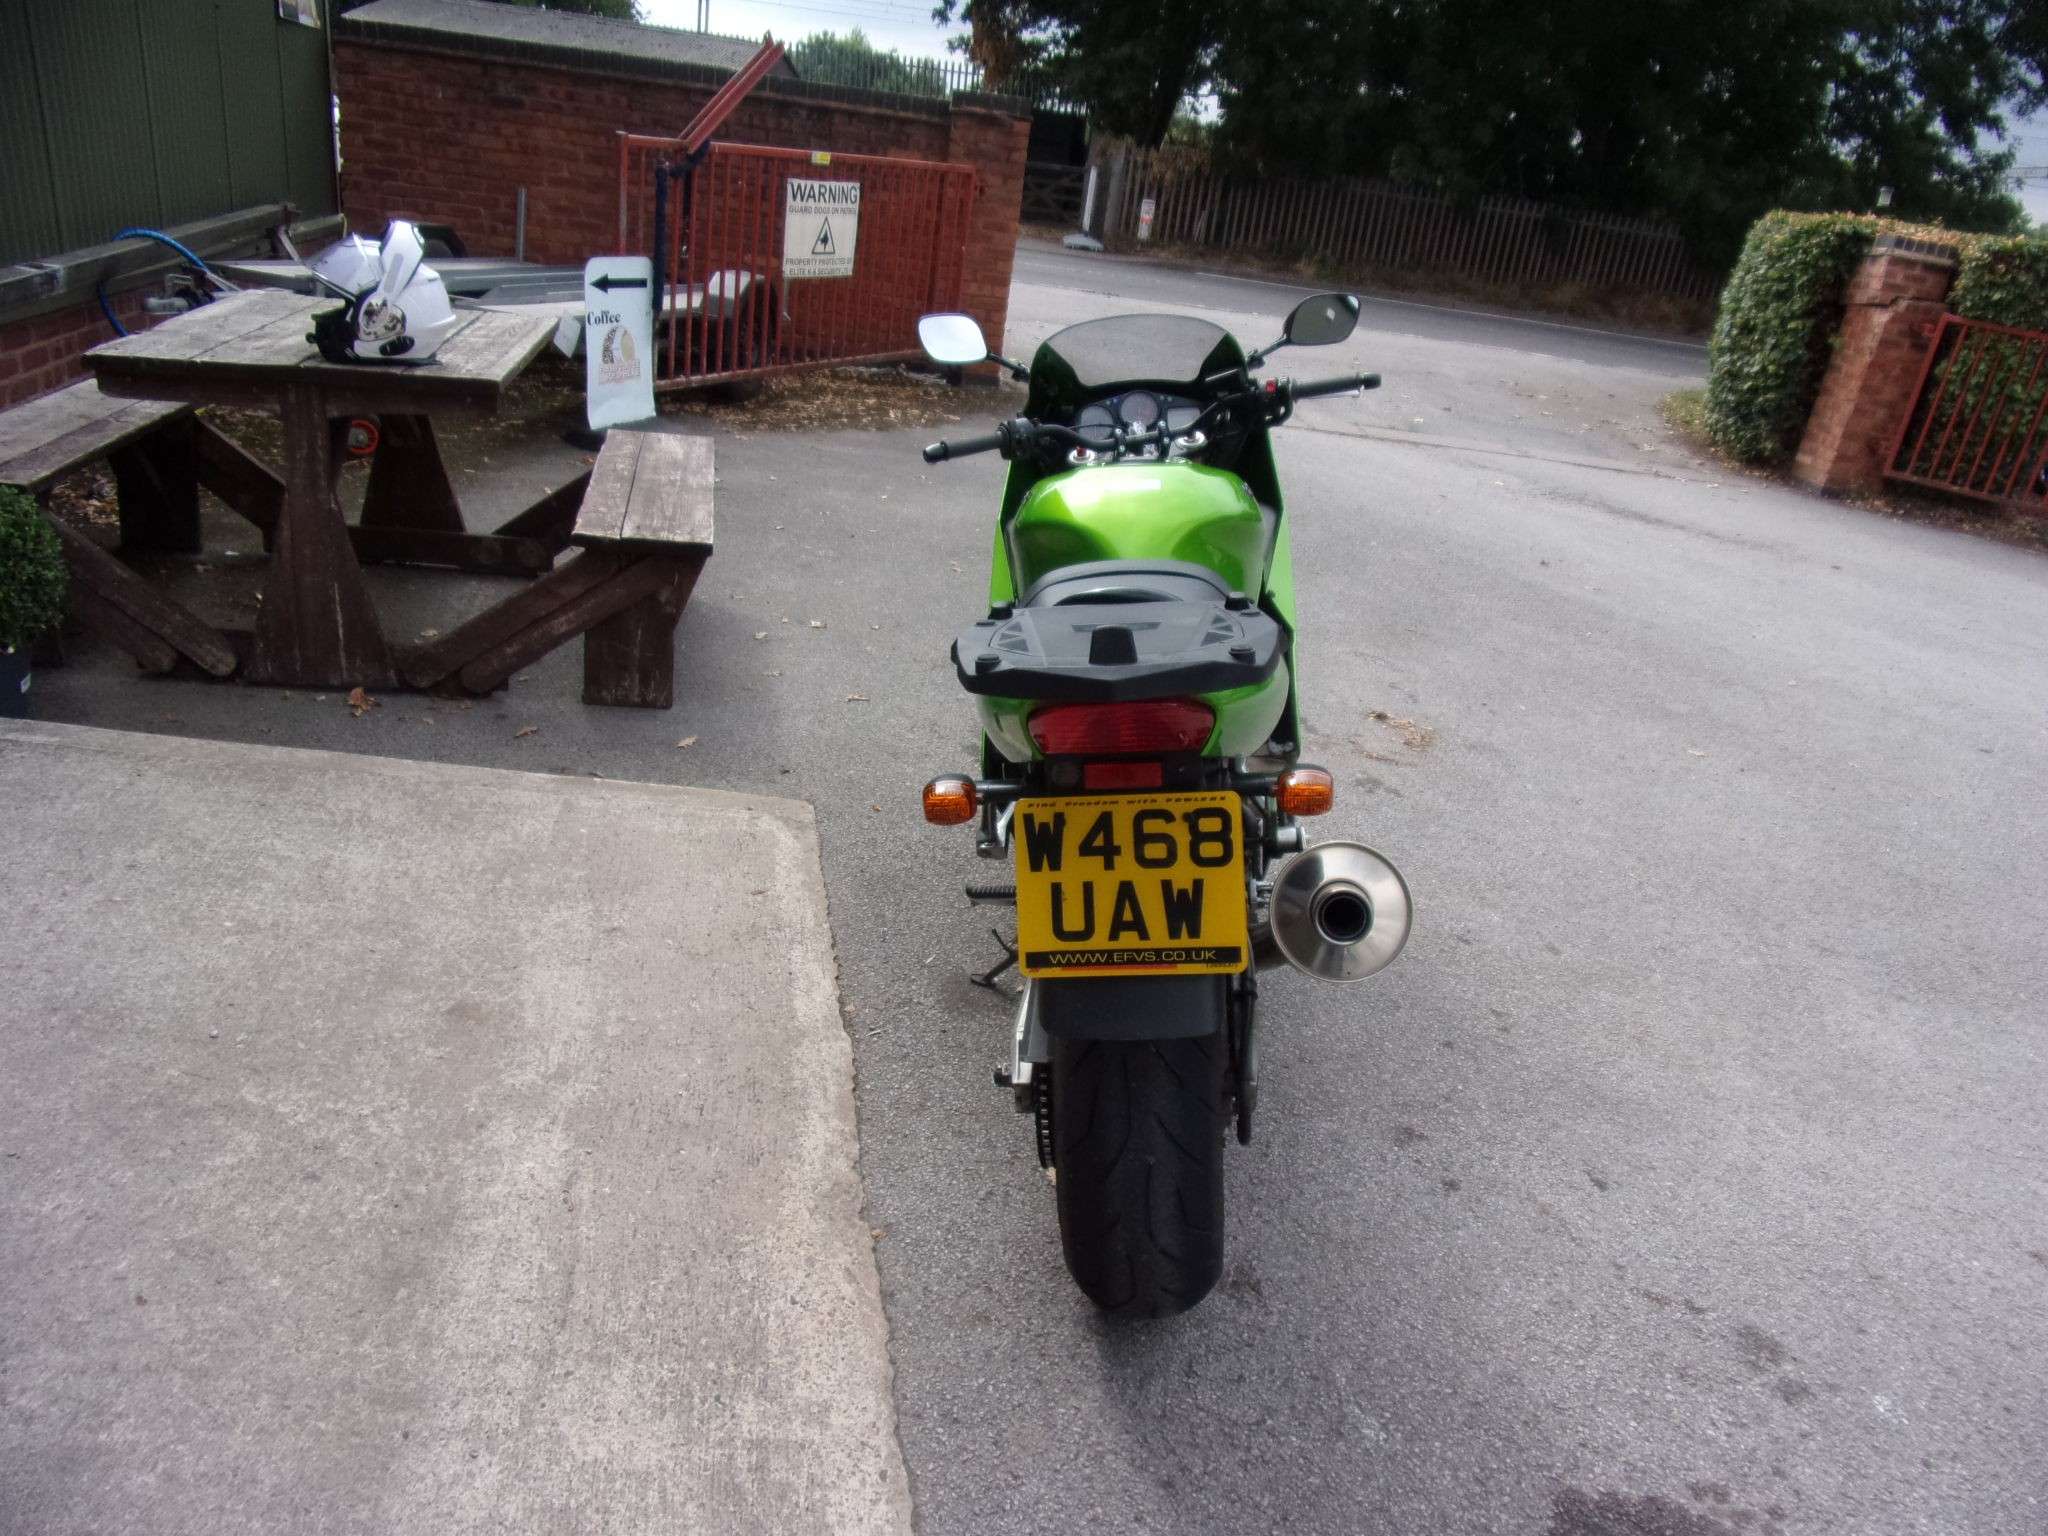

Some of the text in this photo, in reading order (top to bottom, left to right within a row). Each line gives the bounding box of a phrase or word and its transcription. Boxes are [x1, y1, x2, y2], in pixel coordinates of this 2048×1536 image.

[790, 182, 858, 204] WARNING
[789, 205, 813, 215] GUARD
[785, 257, 817, 266] PROPERTY
[587, 310, 621, 325] Coffee
[1023, 806, 1234, 873] W468
[1051, 878, 1204, 942] UAW
[1050, 949, 1217, 964] WWW.EFVS.CO.UK
